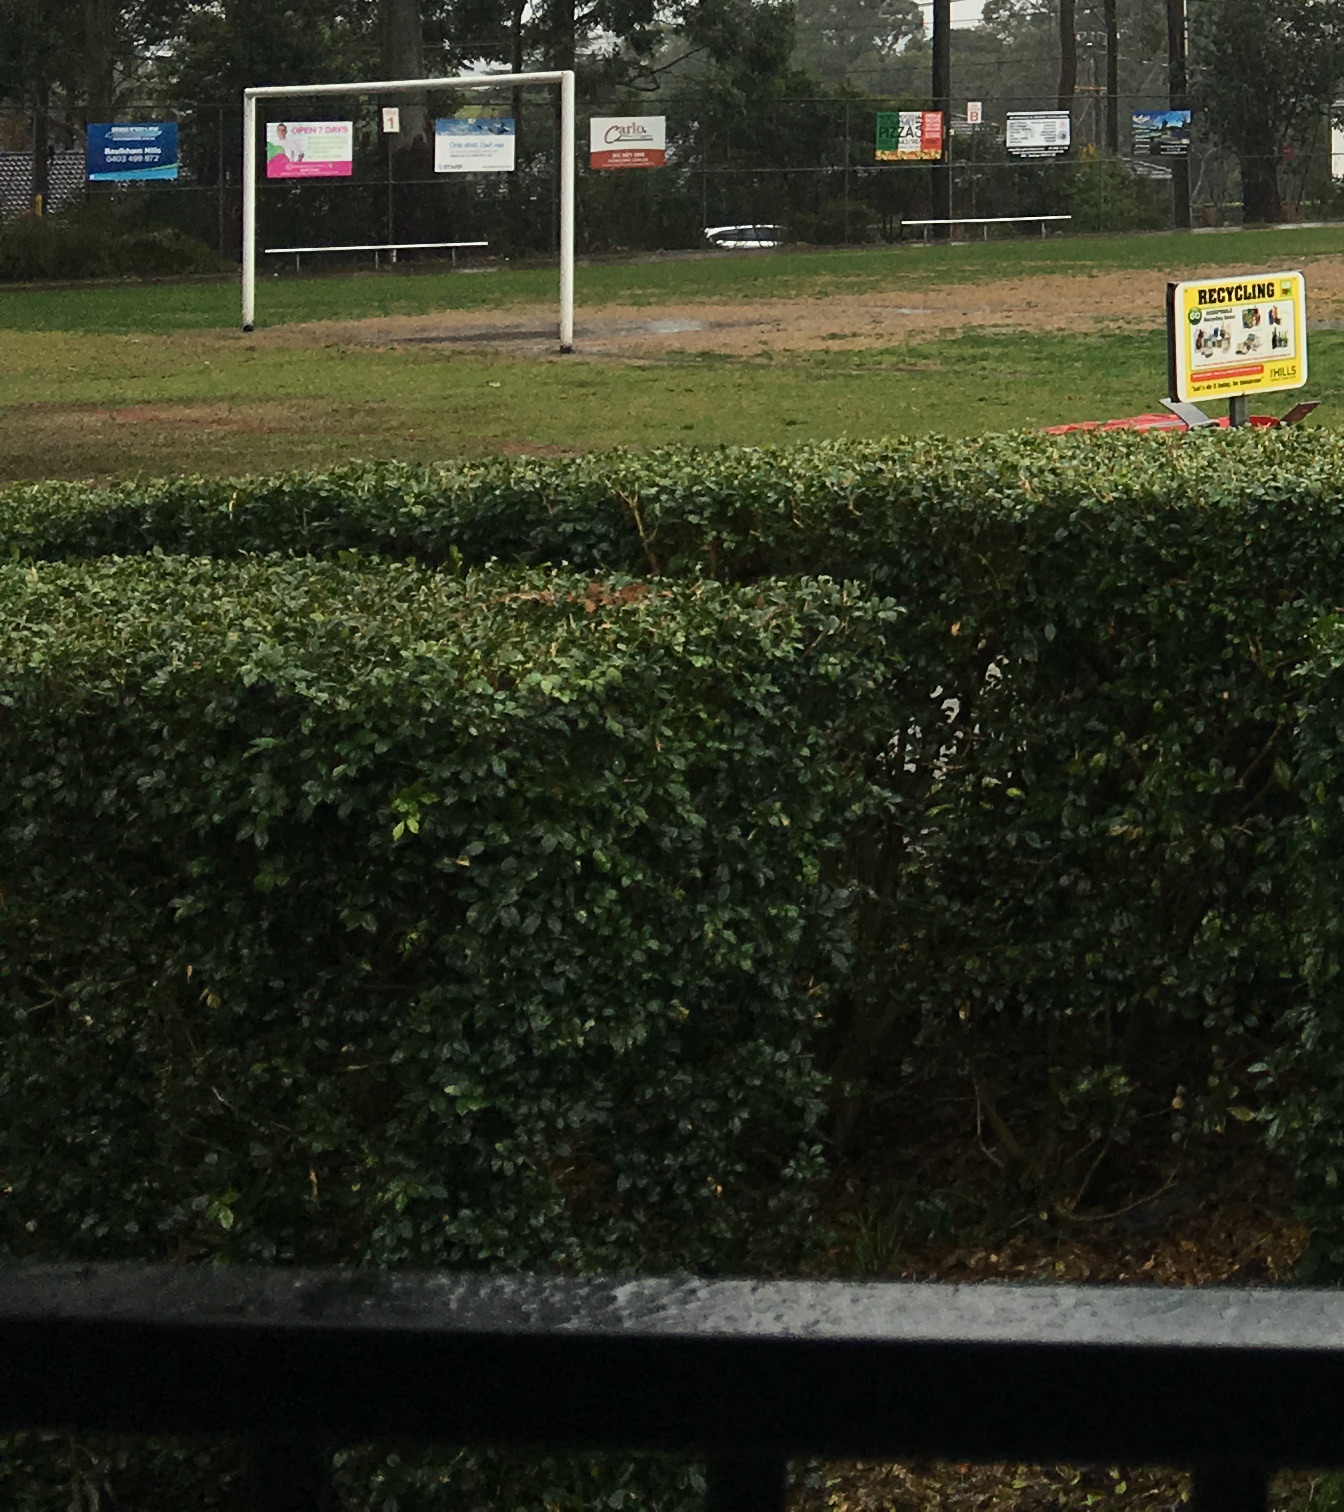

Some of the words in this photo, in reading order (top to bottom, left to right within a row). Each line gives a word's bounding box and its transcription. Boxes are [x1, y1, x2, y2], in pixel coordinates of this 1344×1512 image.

[387, 117, 394, 130] 1
[291, 126, 316, 135] OPEN
[318, 126, 323, 134] 7
[325, 126, 348, 134] DAYS
[1198, 282, 1275, 305] RECYCLING
[1273, 365, 1297, 377] HILLS
